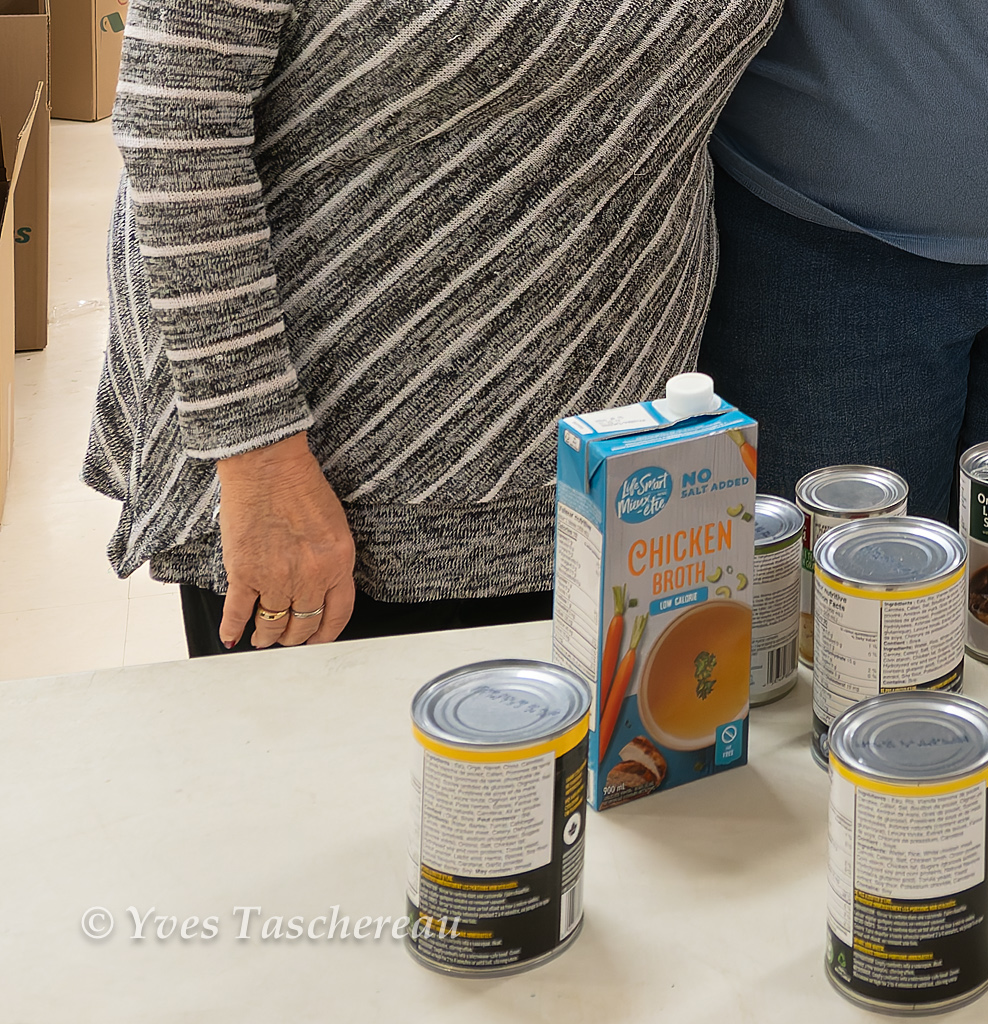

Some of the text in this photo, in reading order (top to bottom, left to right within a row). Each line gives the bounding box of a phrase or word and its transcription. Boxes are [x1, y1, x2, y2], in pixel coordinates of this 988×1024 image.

[638, 472, 669, 496] Smart
[680, 477, 749, 499] SALT ADDED
[682, 468, 712, 488] NO
[627, 519, 733, 577] CHICKEN
[652, 560, 706, 595] BROTH
[659, 592, 698, 611] LOW CALORIE
[602, 785, 615, 796] 900
